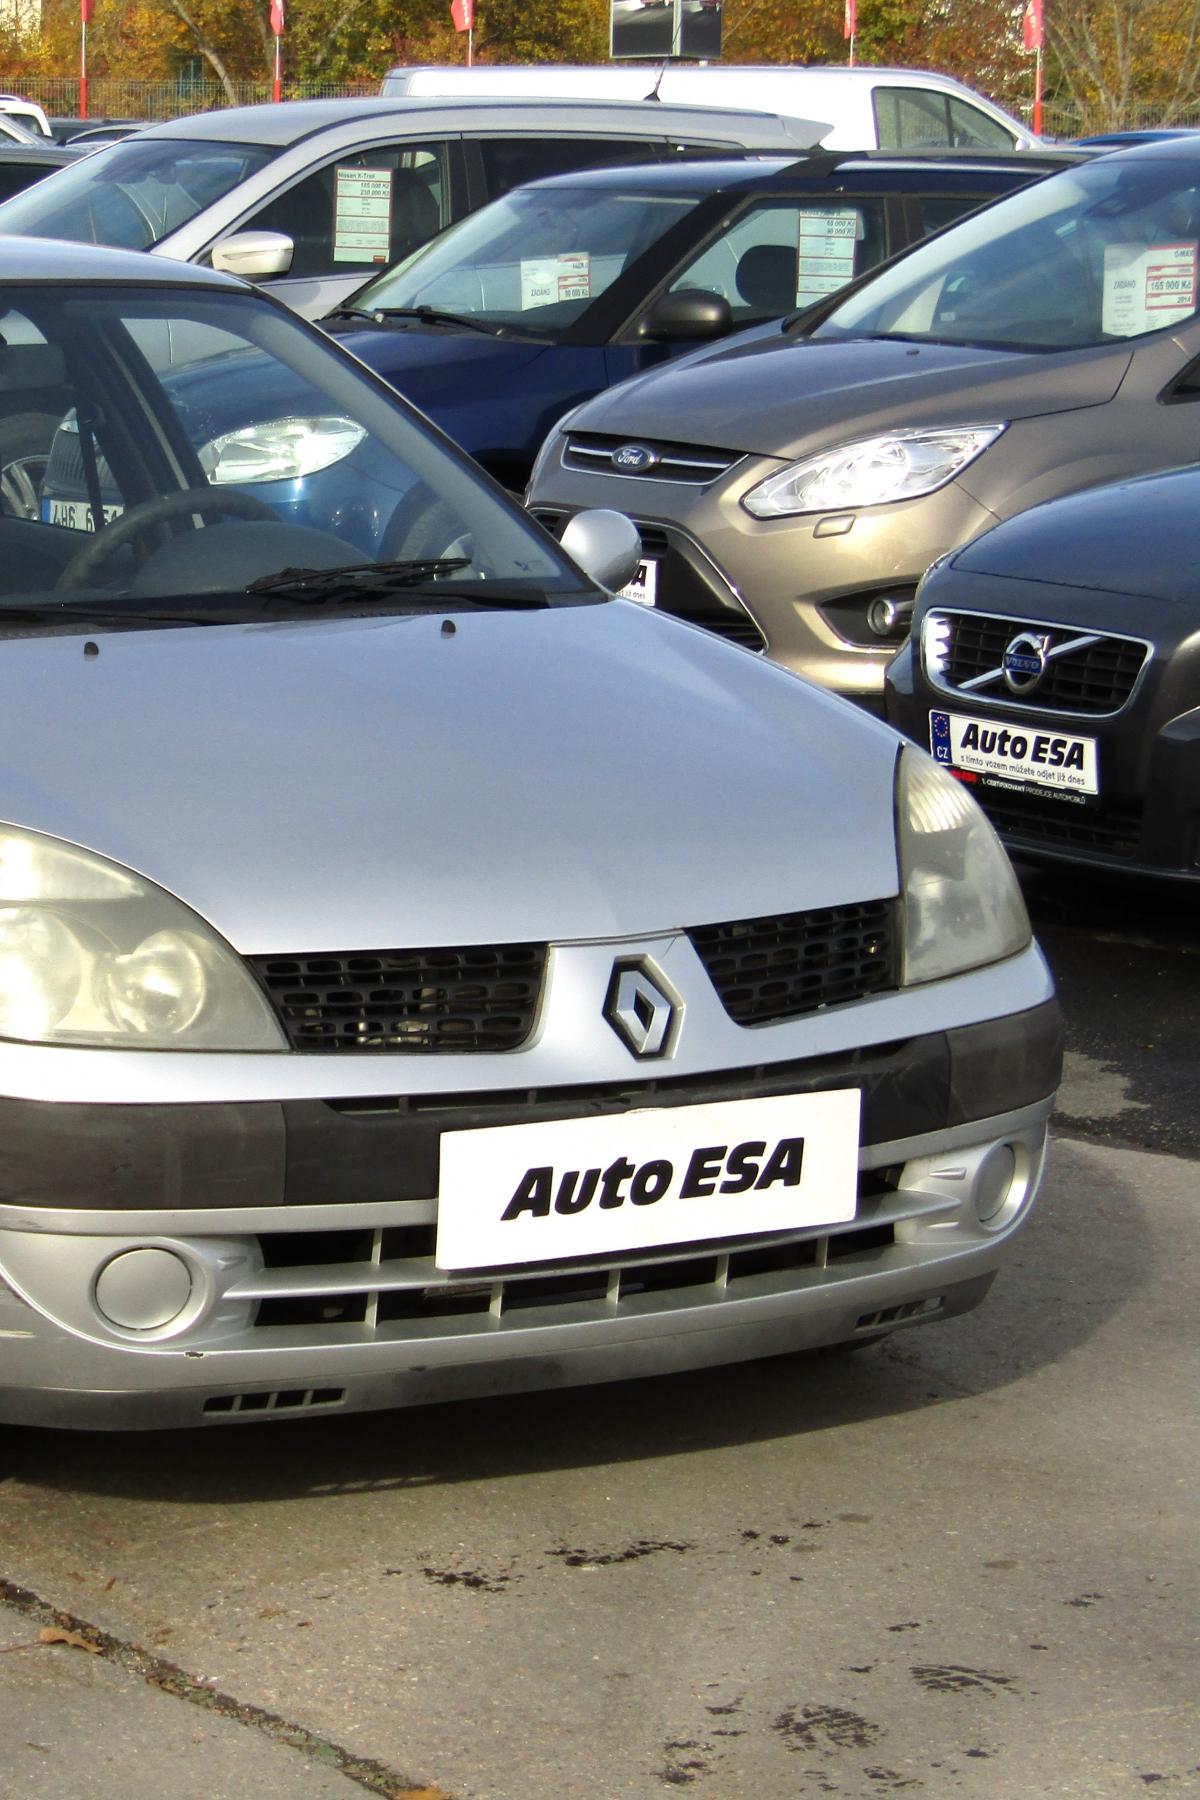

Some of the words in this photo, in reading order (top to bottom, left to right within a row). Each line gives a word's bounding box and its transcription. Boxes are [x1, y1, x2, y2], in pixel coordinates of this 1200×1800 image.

[1166, 280, 1180, 290] 000
[618, 448, 643, 465] Ford
[1006, 656, 1038, 669] VOLVO
[936, 745, 949, 759] CZ
[960, 723, 1028, 760] Auto
[1031, 735, 1084, 771] ESA
[985, 760, 1008, 770] vozem
[1036, 769, 1056, 780] odjet
[1067, 774, 1086, 786] dnes
[500, 1157, 674, 1222] Auto
[678, 1137, 805, 1200] ESA
